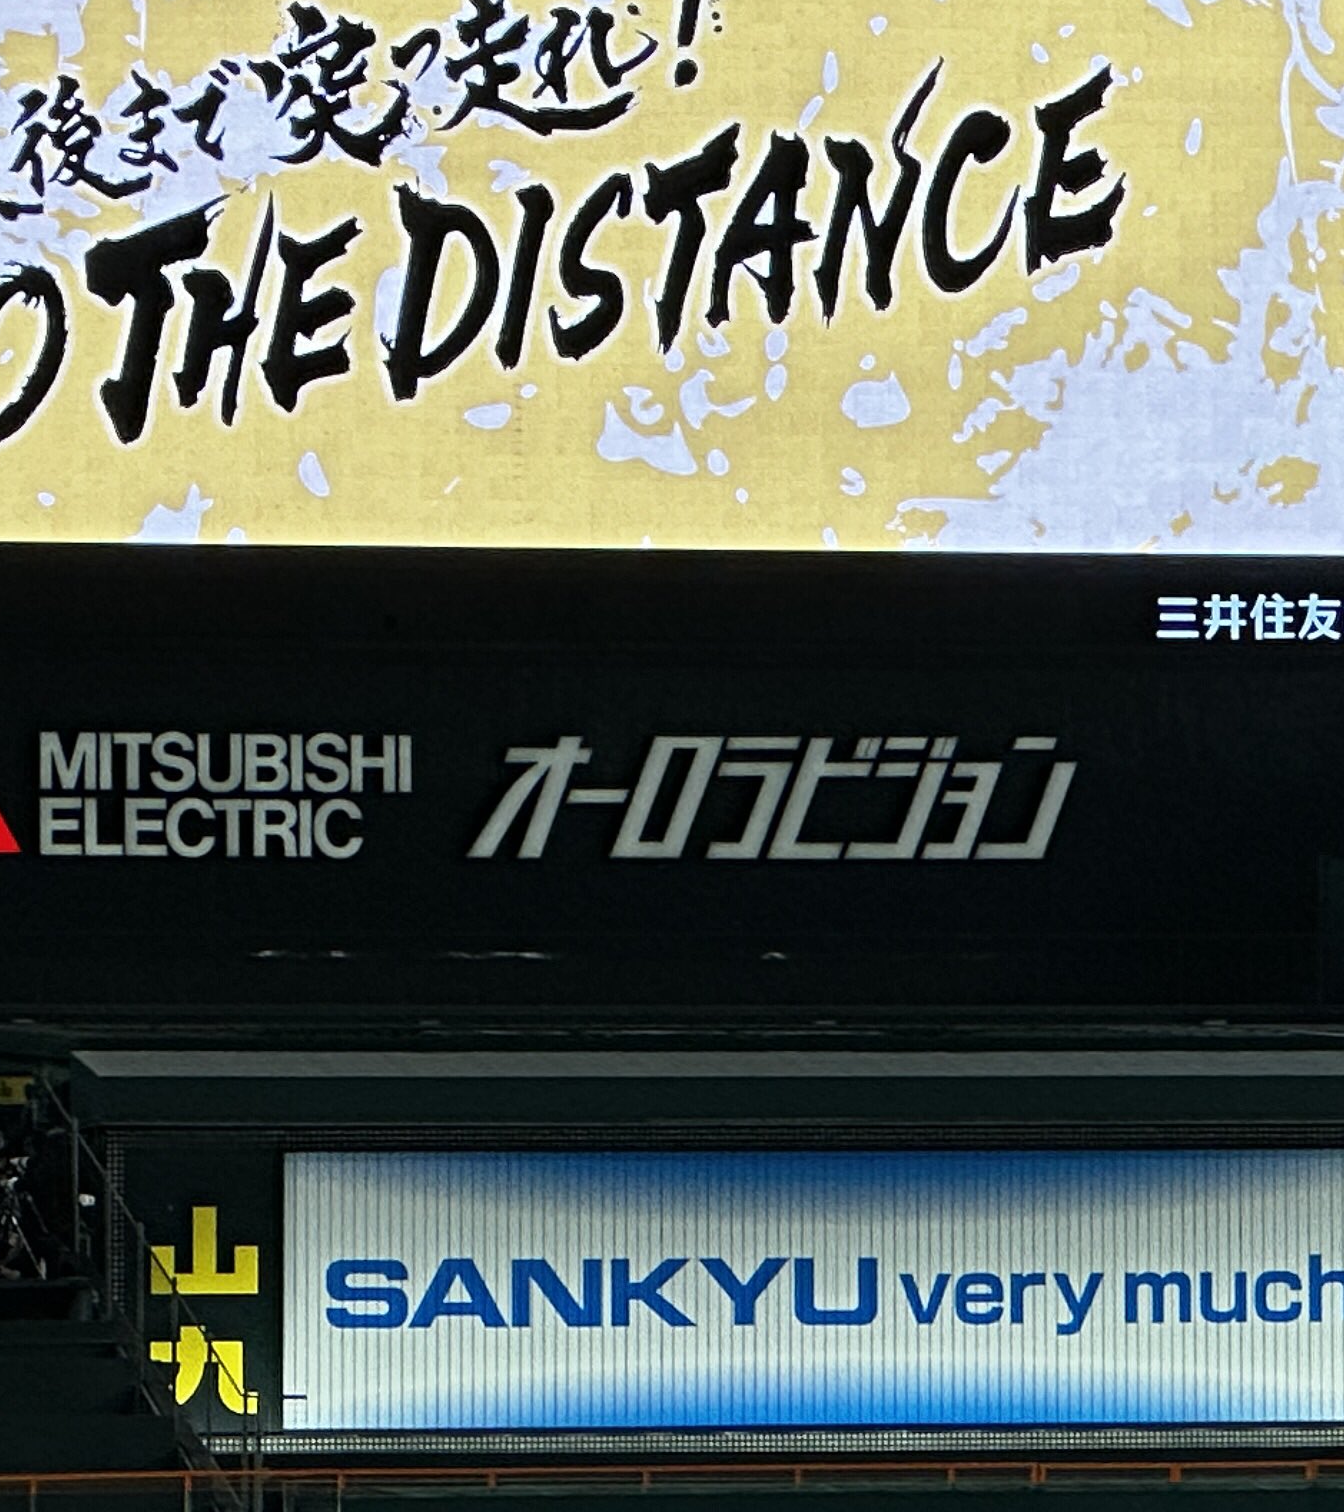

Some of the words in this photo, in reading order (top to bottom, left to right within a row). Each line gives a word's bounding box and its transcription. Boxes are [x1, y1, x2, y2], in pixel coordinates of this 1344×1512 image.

[86, 194, 364, 445] THE
[381, 59, 1124, 400] DISTANCE
[40, 732, 411, 792] MITSUBISHI
[468, 736, 1077, 859] オーロラビジョン
[40, 798, 364, 858] ELECTRIC
[150, 1206, 258, 1415] 山九
[326, 1257, 879, 1329] SANKYU
[899, 1271, 1105, 1335] very
